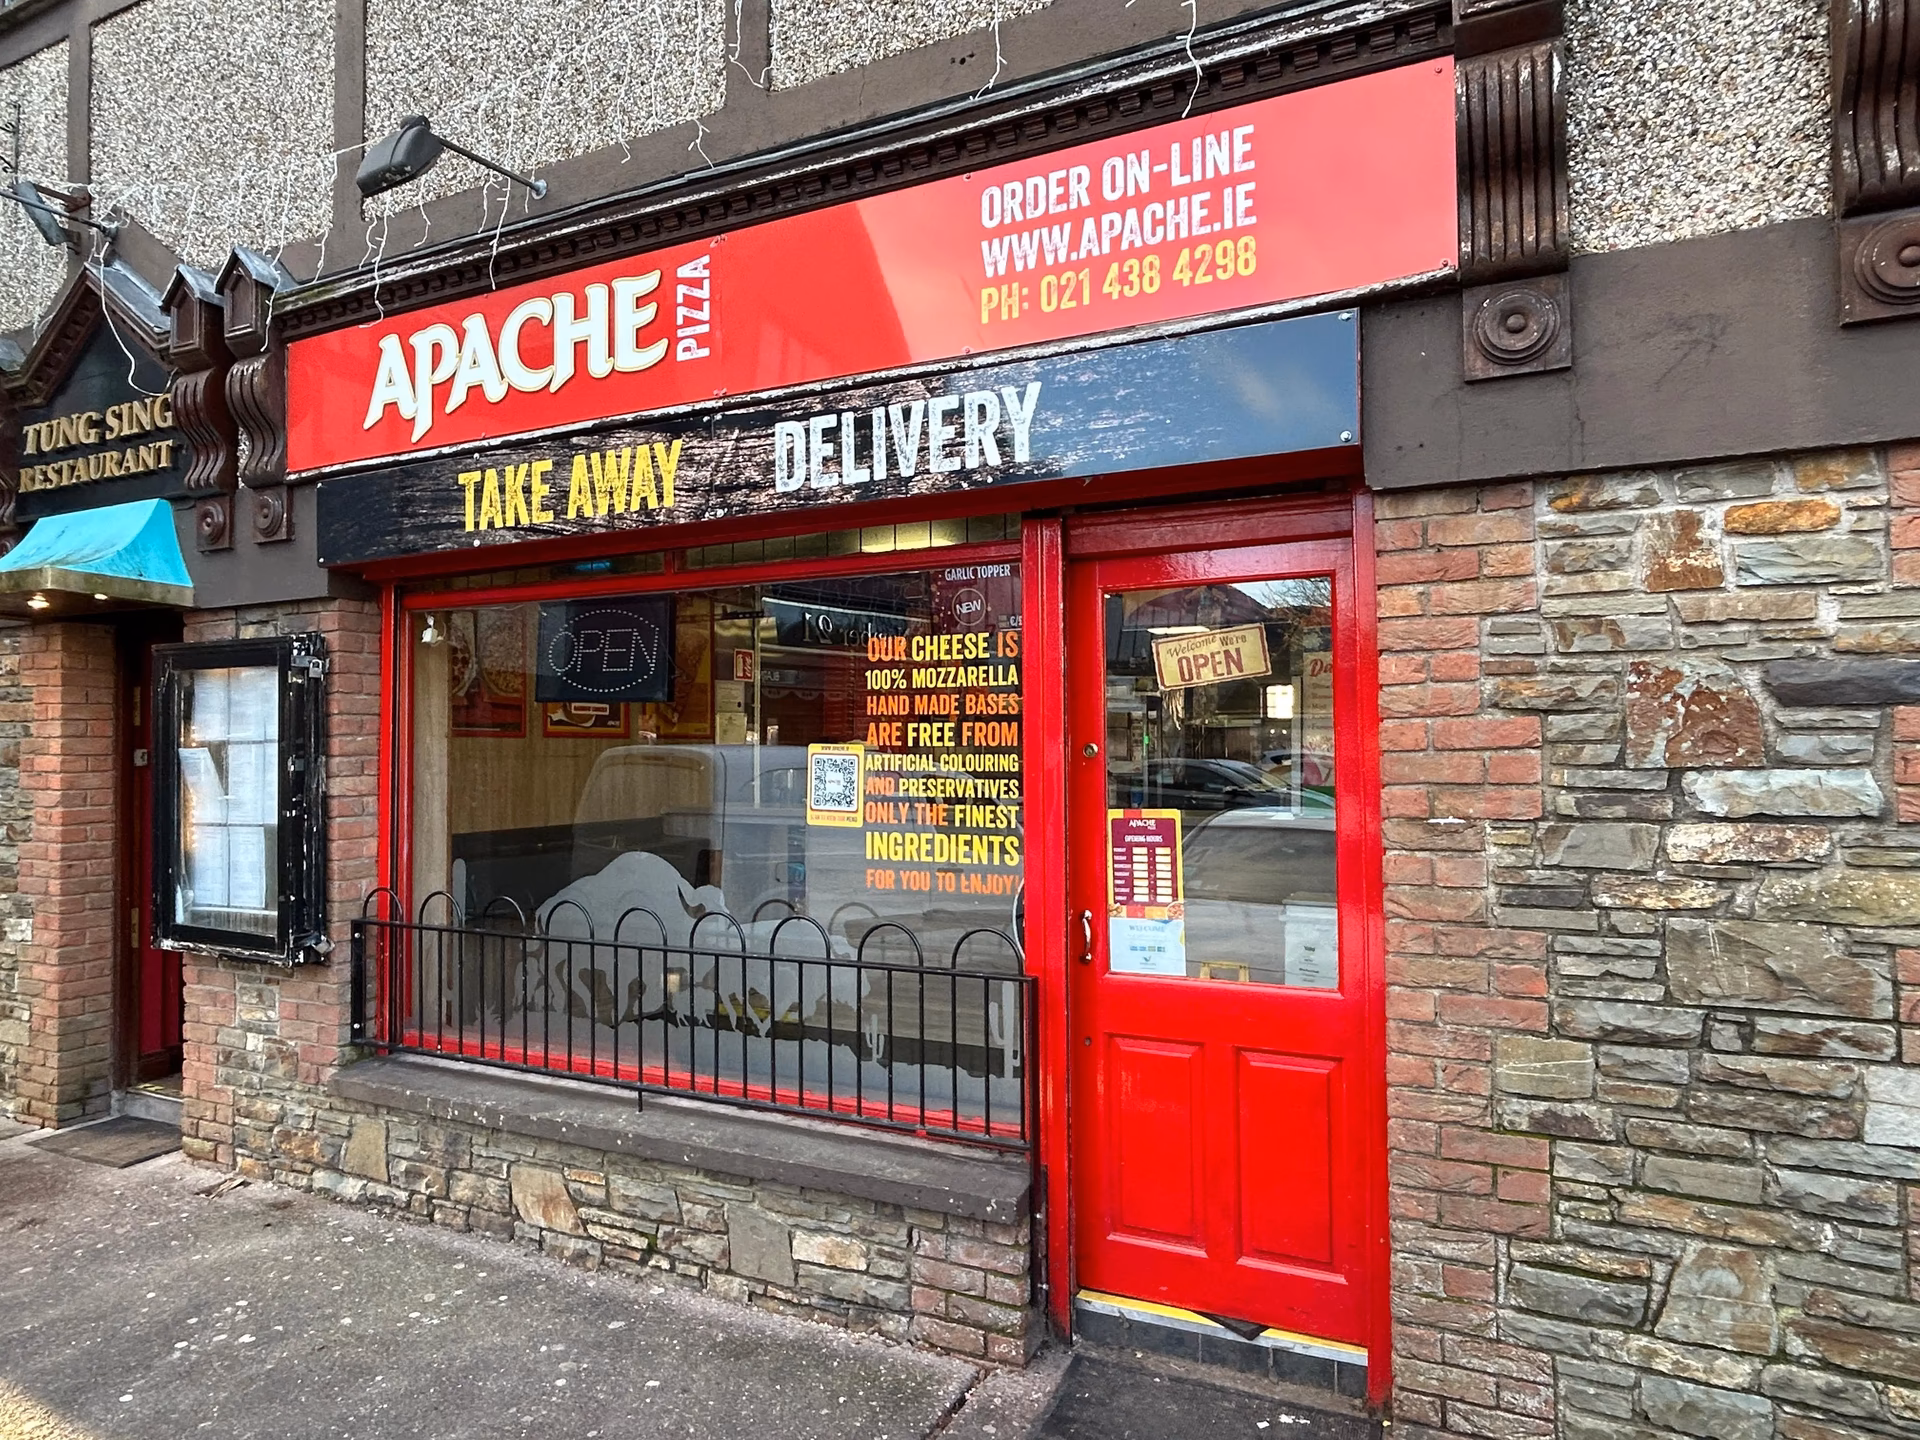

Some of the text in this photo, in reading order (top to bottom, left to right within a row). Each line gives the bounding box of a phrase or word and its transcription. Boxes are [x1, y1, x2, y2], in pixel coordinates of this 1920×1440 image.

[980, 124, 1256, 229] ORDER ON-LINE
[981, 181, 1258, 279] WWW.APACHE.IE
[980, 235, 1257, 325] PH: 021 438 4298
[676, 253, 711, 362] PIZZA
[362, 269, 669, 444] APACHE
[22, 393, 174, 456] TUNG SING
[774, 381, 1043, 493] DELIVERY
[18, 439, 174, 494] RESTAURANT
[458, 439, 683, 532] TAKE AWAY
[944, 563, 1011, 581] GARLIC TOPPER
[955, 599, 981, 615] NEW
[548, 626, 660, 675] OPEN
[867, 631, 1019, 662] OUR CHEESE IS
[1166, 634, 1247, 658] Welcome We're
[865, 664, 1019, 690] 100% MOZZARELLA
[1177, 647, 1244, 683] OPEN
[866, 693, 1019, 716] HAND MADE BASES
[866, 721, 1018, 747] ARE FREE FROM
[865, 753, 1019, 772] ARTIFICIAL COLOURING
[865, 776, 1019, 799] AND PRESERVATIVES
[865, 801, 1020, 828] ONLY THE FINEST
[865, 831, 1020, 867] INGREDIENTS
[866, 868, 1020, 895] FOR YOU TO ENJOY!
